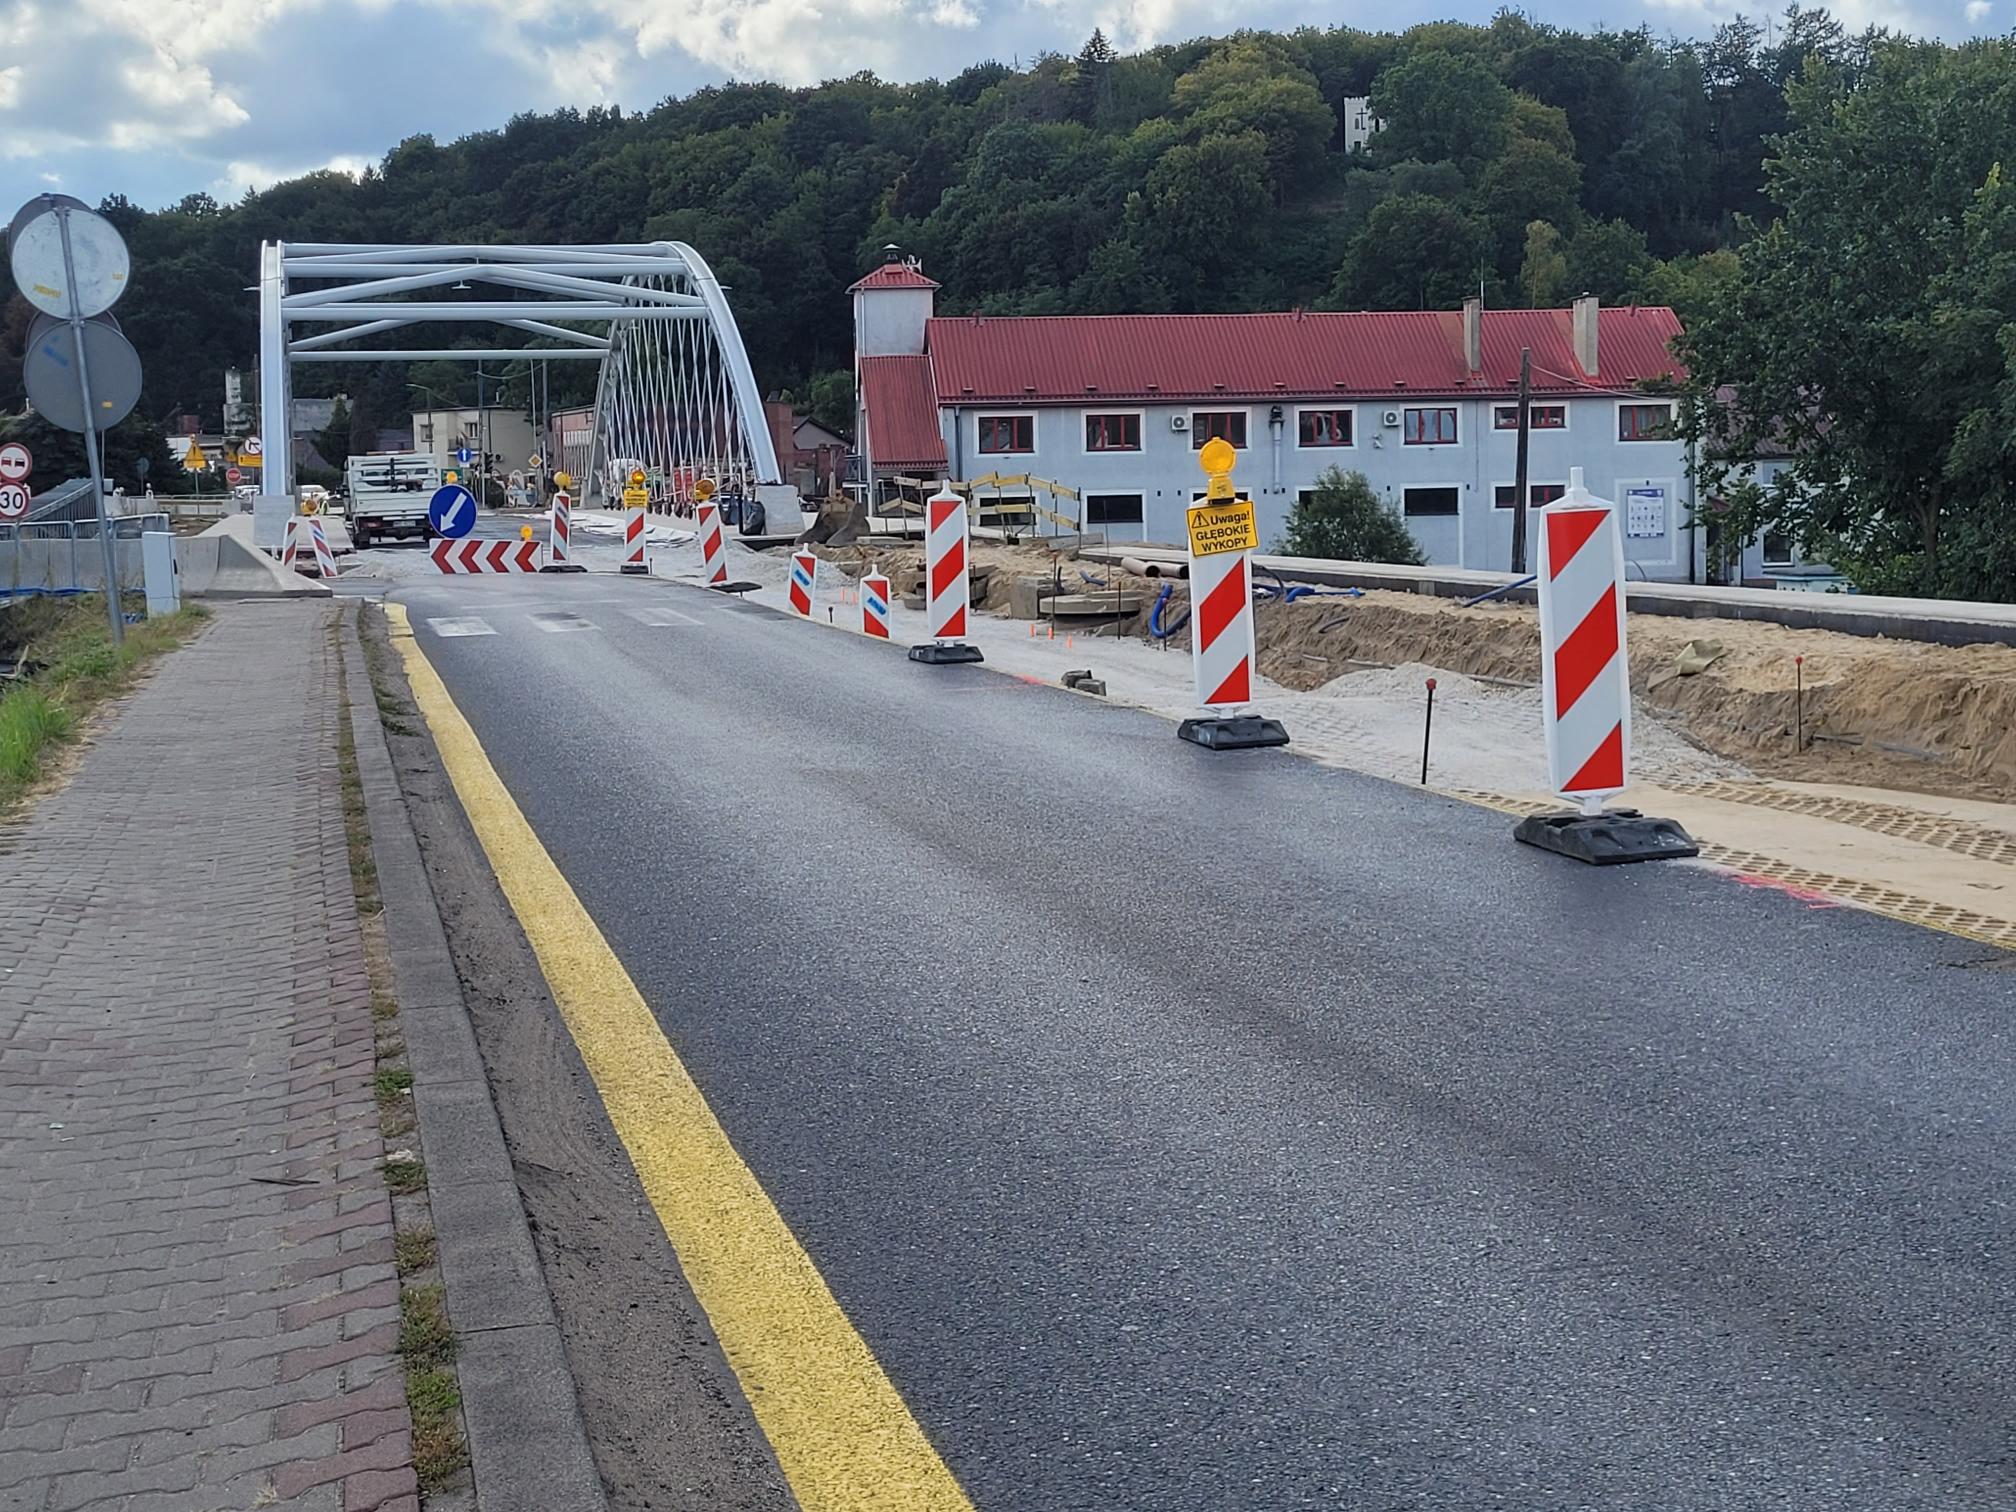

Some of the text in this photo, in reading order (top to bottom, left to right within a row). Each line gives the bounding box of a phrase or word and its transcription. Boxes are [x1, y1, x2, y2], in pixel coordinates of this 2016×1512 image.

[0, 491, 23, 509] 30
[1210, 510, 1250, 525] Uwaga!
[1196, 524, 1251, 541] GŁĘBOKIE
[1201, 536, 1248, 552] WYKOPY
